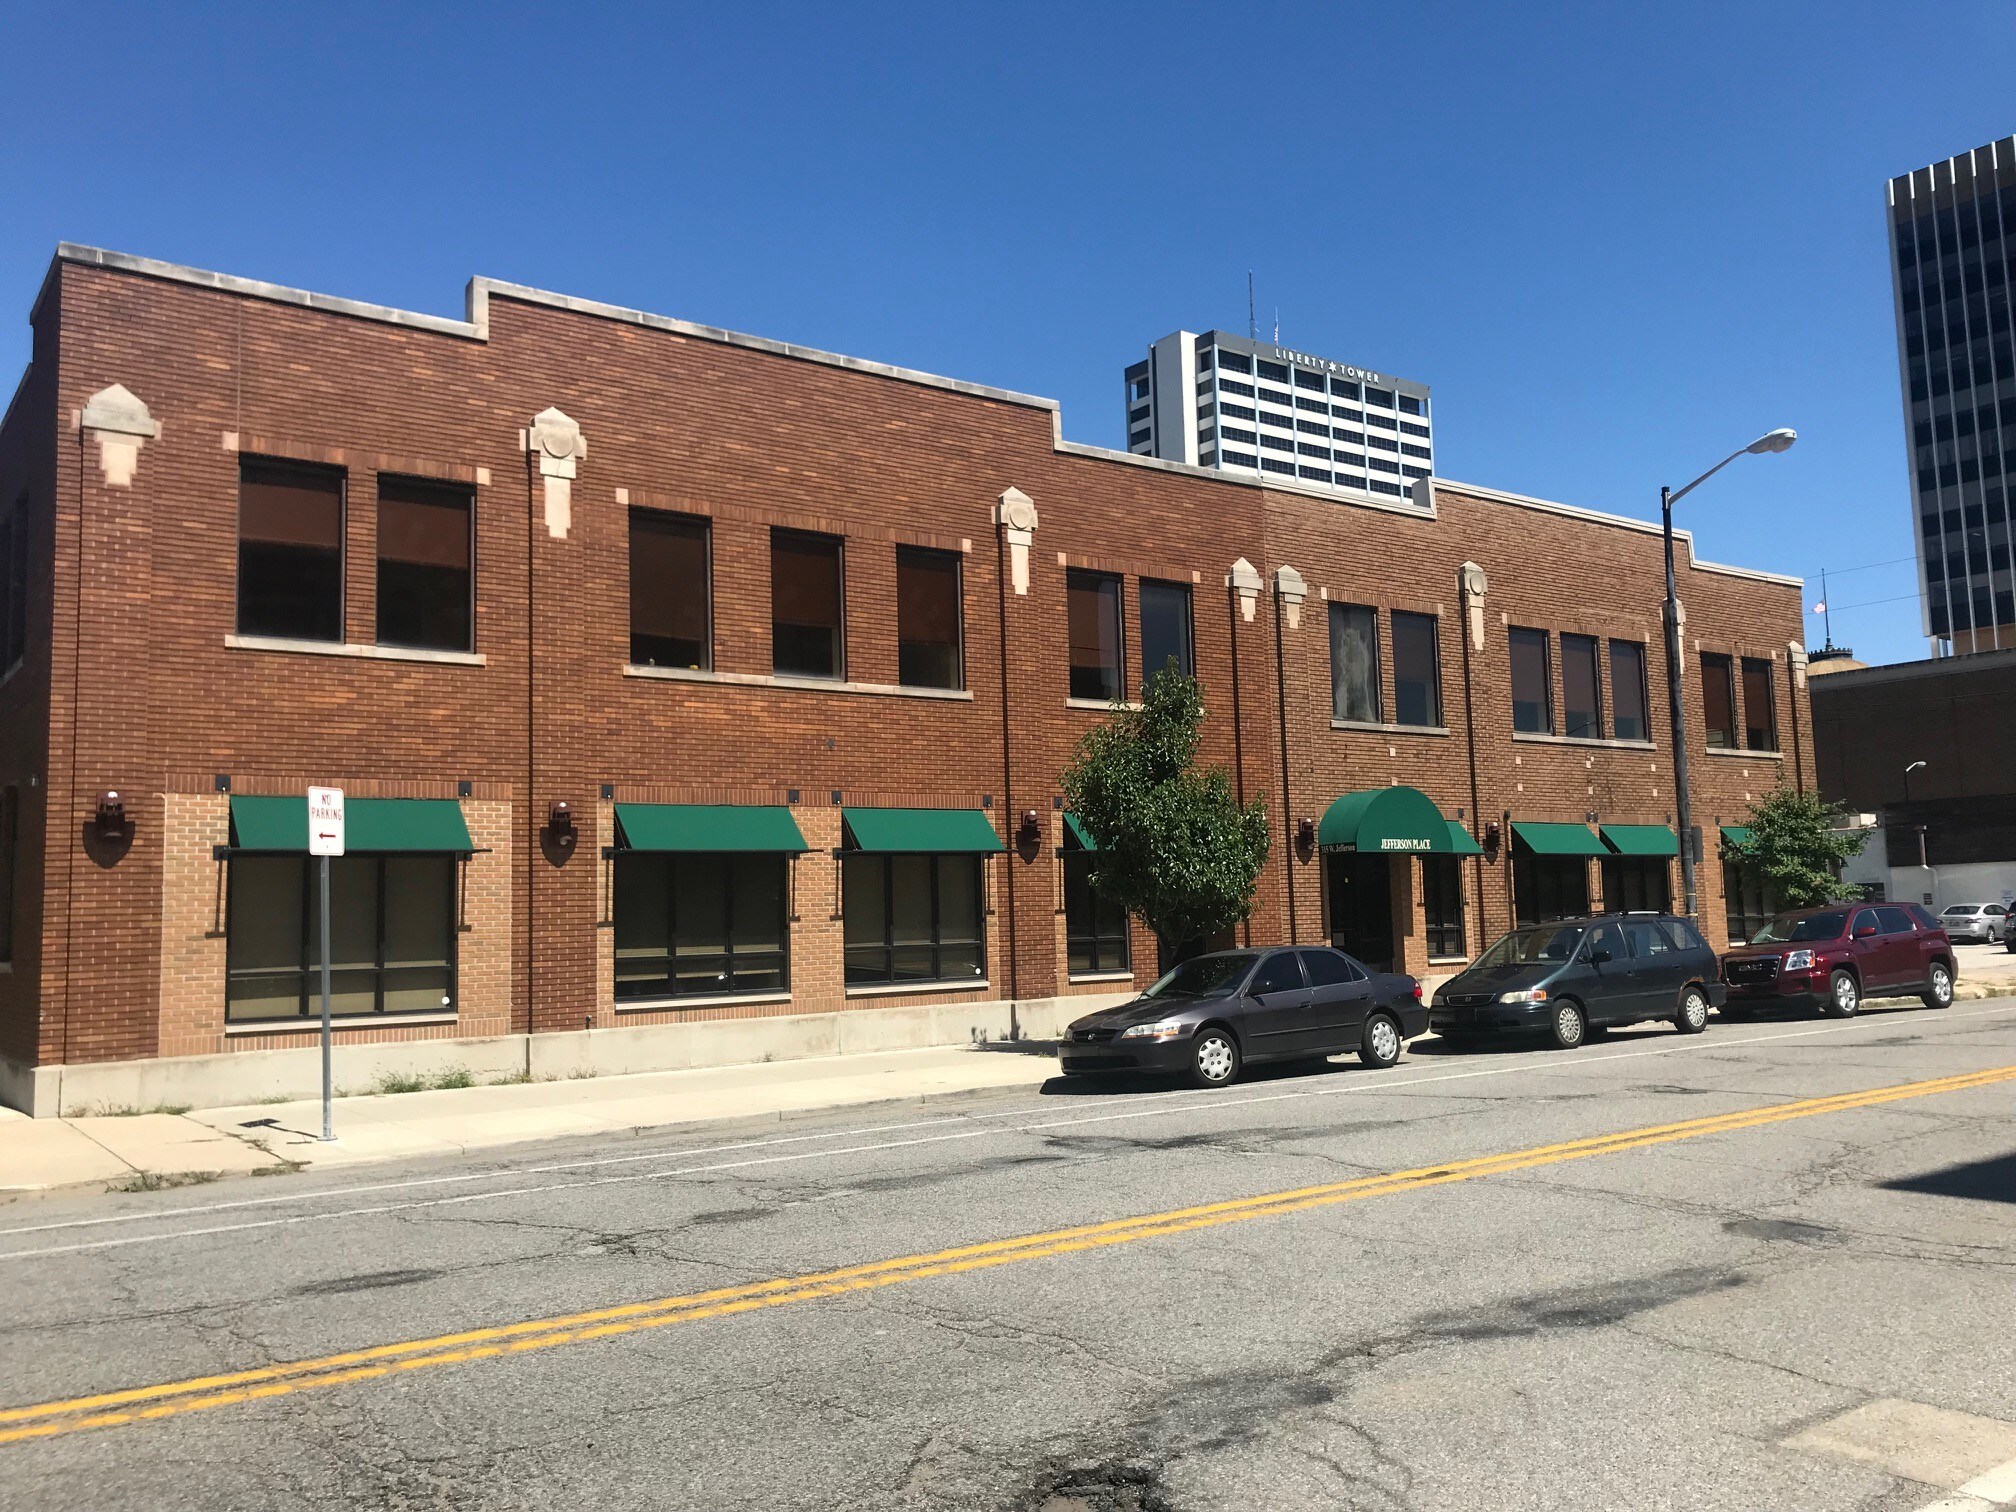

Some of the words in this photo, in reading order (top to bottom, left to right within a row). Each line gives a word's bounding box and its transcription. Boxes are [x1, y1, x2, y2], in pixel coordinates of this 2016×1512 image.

[1276, 348, 1325, 369] LIBERTY
[1340, 364, 1380, 384] TOWER
[321, 794, 332, 805] NO
[311, 807, 342, 821] PARKING
[1381, 838, 1412, 849] JEFFERSON
[1412, 838, 1431, 849] PLACE
